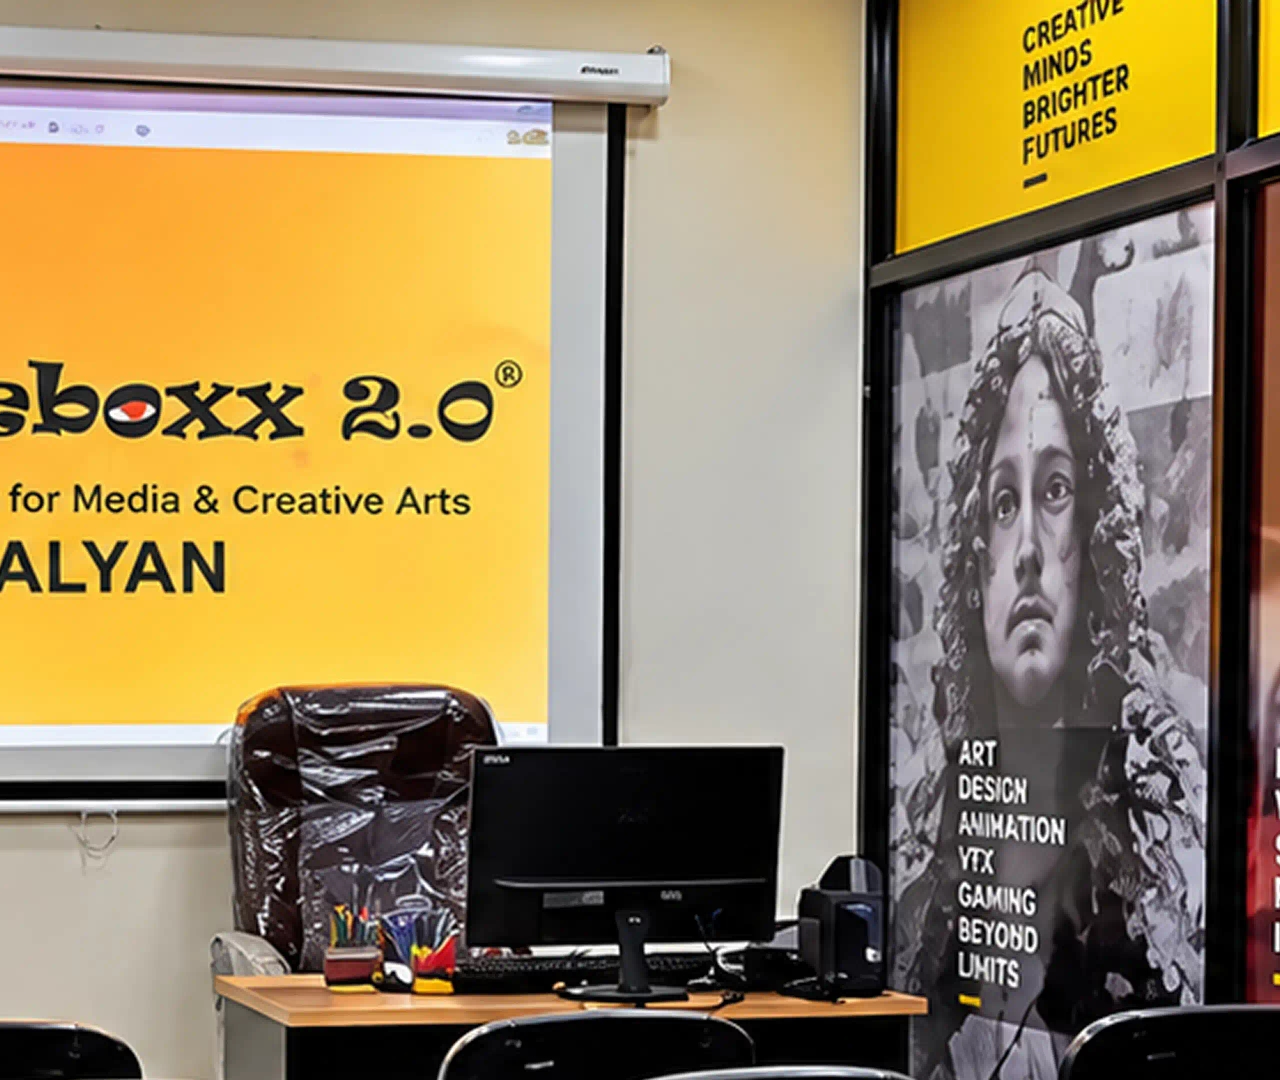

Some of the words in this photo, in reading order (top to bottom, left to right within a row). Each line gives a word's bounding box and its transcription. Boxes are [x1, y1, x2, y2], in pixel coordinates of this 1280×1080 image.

[1023, 38, 1093, 91] MINDS
[1023, 63, 1130, 129] BRIGHTER
[1023, 106, 1118, 165] FUTURES
[8, 482, 61, 513] for
[73, 483, 180, 514] Media
[193, 484, 219, 515] &
[233, 485, 384, 515] Creative
[395, 486, 471, 515] Arts
[959, 740, 997, 767] ART
[958, 811, 1065, 845] ANIMATION
[959, 916, 1038, 955] BEYOND
